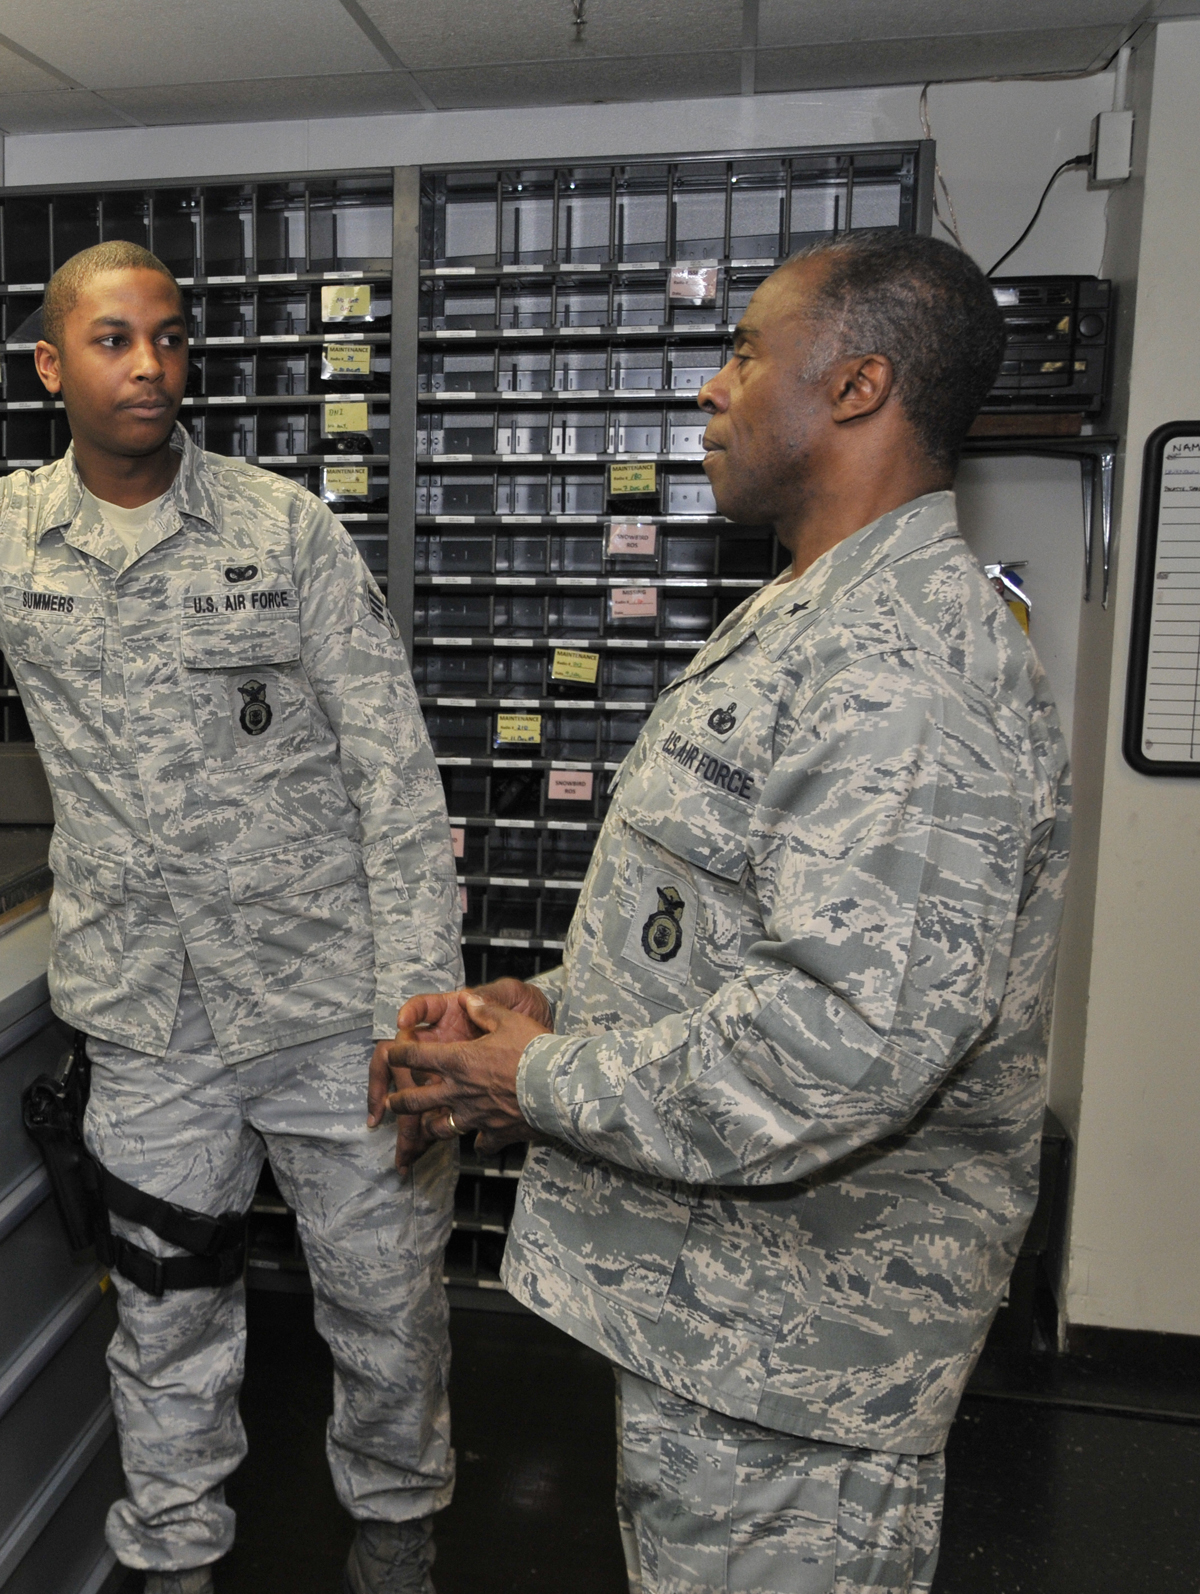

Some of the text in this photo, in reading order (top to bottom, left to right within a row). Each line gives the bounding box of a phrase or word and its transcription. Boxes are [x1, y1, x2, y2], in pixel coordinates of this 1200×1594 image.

[22, 591, 74, 613] SUMMERS
[193, 590, 289, 614] U.S. AIR FORCE
[556, 651, 598, 661] MAINTENANCE
[674, 740, 700, 770] AIR
[694, 752, 755, 800] FORCE
